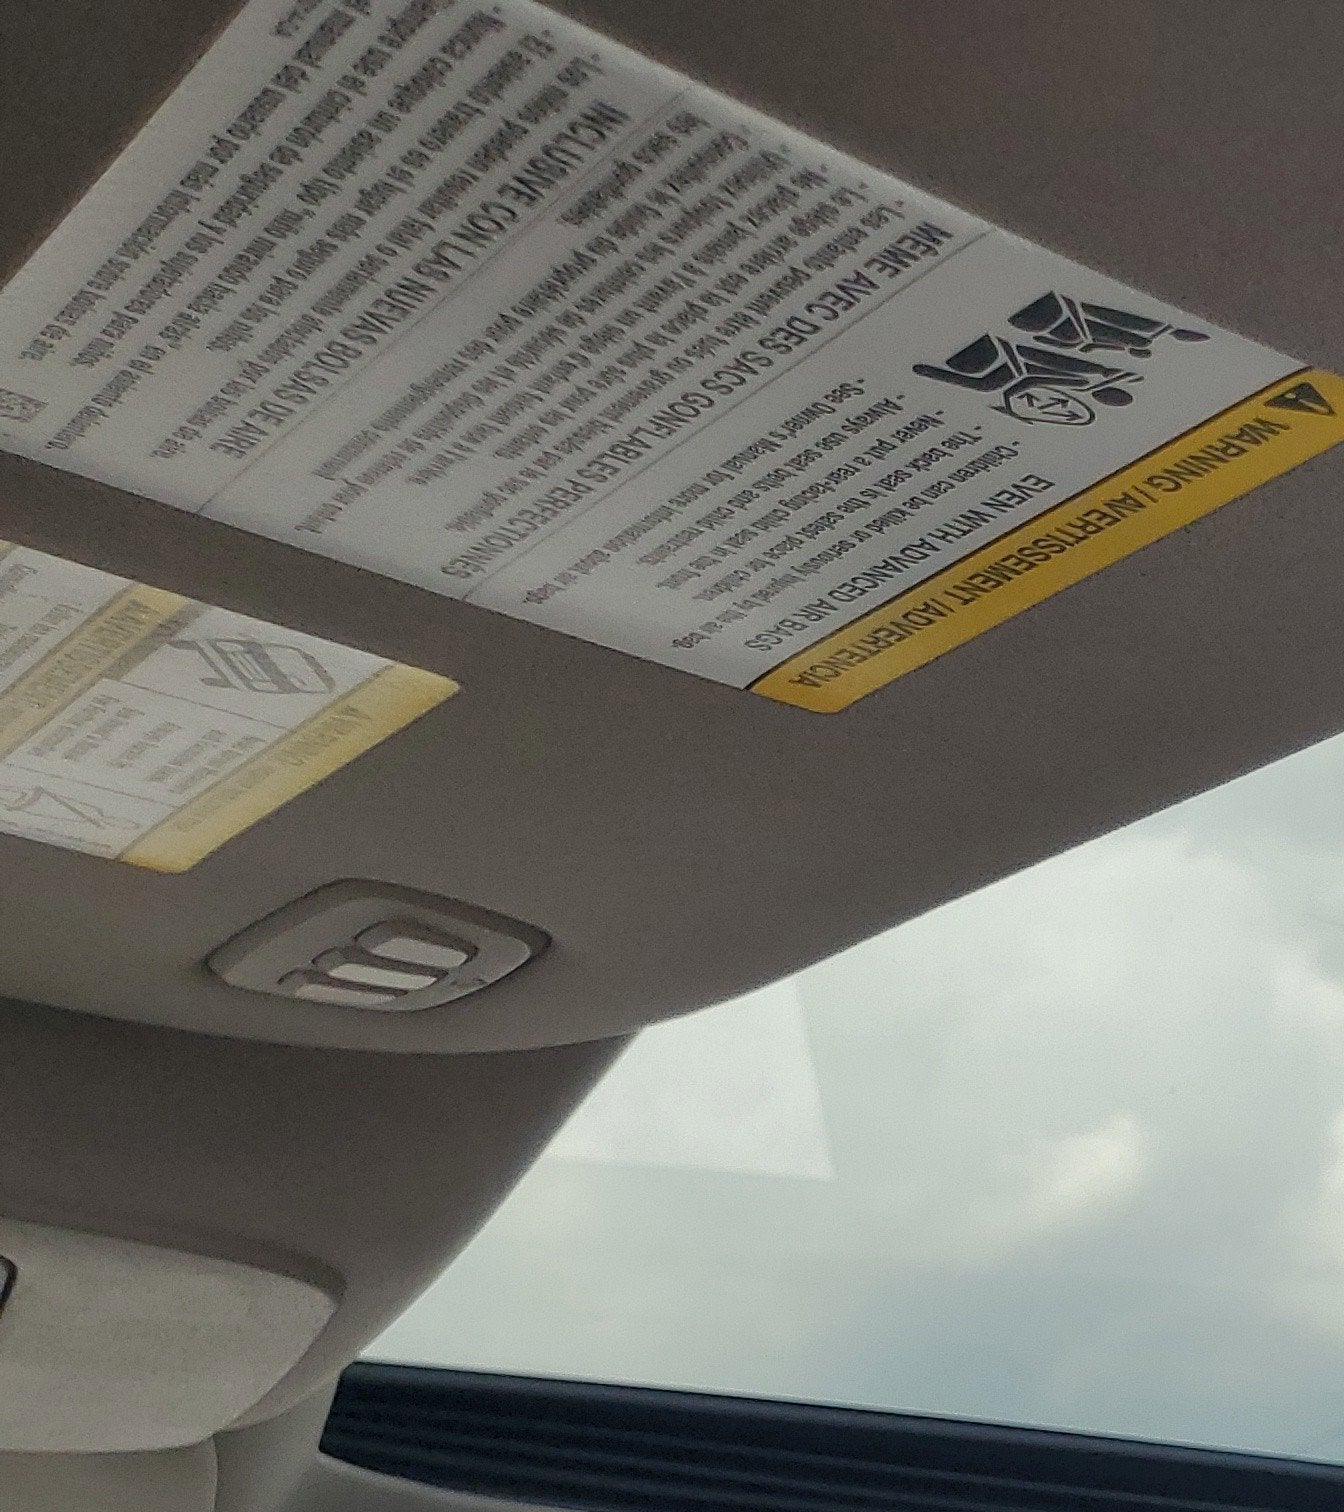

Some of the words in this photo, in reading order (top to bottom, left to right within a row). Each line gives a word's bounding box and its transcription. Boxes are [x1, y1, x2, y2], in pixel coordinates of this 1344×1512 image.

[449, 200, 524, 247] CON
[410, 242, 477, 281] LAS
[862, 222, 960, 279] MÊME
[799, 271, 886, 321] AVEC
[337, 277, 437, 345] NUEVAS
[754, 317, 822, 354] DES
[270, 341, 364, 404] BOLSAS
[697, 350, 776, 394] SACS
[246, 398, 294, 427] DE
[209, 421, 272, 457] AIRE
[573, 391, 718, 481] GONFLABLES
[814, 431, 849, 451] use
[859, 438, 902, 461] put
[719, 439, 781, 472] Manual
[783, 448, 827, 472] seat
[849, 455, 874, 466] a
[904, 446, 953, 474] back
[1140, 416, 1293, 493] WARNING
[700, 468, 734, 487] for
[777, 463, 865, 510] rear-facing
[873, 468, 918, 493] seat
[920, 479, 955, 499] can
[668, 482, 709, 507] more
[725, 488, 765, 510] and
[835, 496, 872, 516] the
[901, 495, 932, 512] be
[980, 475, 1055, 511] EVEN
[693, 505, 740, 531] child
[750, 507, 795, 532] child
[794, 512, 849, 539] safest
[863, 506, 915, 534] killed
[926, 508, 997, 542] WITH
[722, 527, 762, 549] seat
[758, 534, 808, 561] place
[845, 529, 874, 542] or
[788, 539, 861, 575] seriously
[824, 540, 945, 601] ADVANCED
[792, 598, 842, 623] AIR
[740, 620, 809, 651] BAGS
